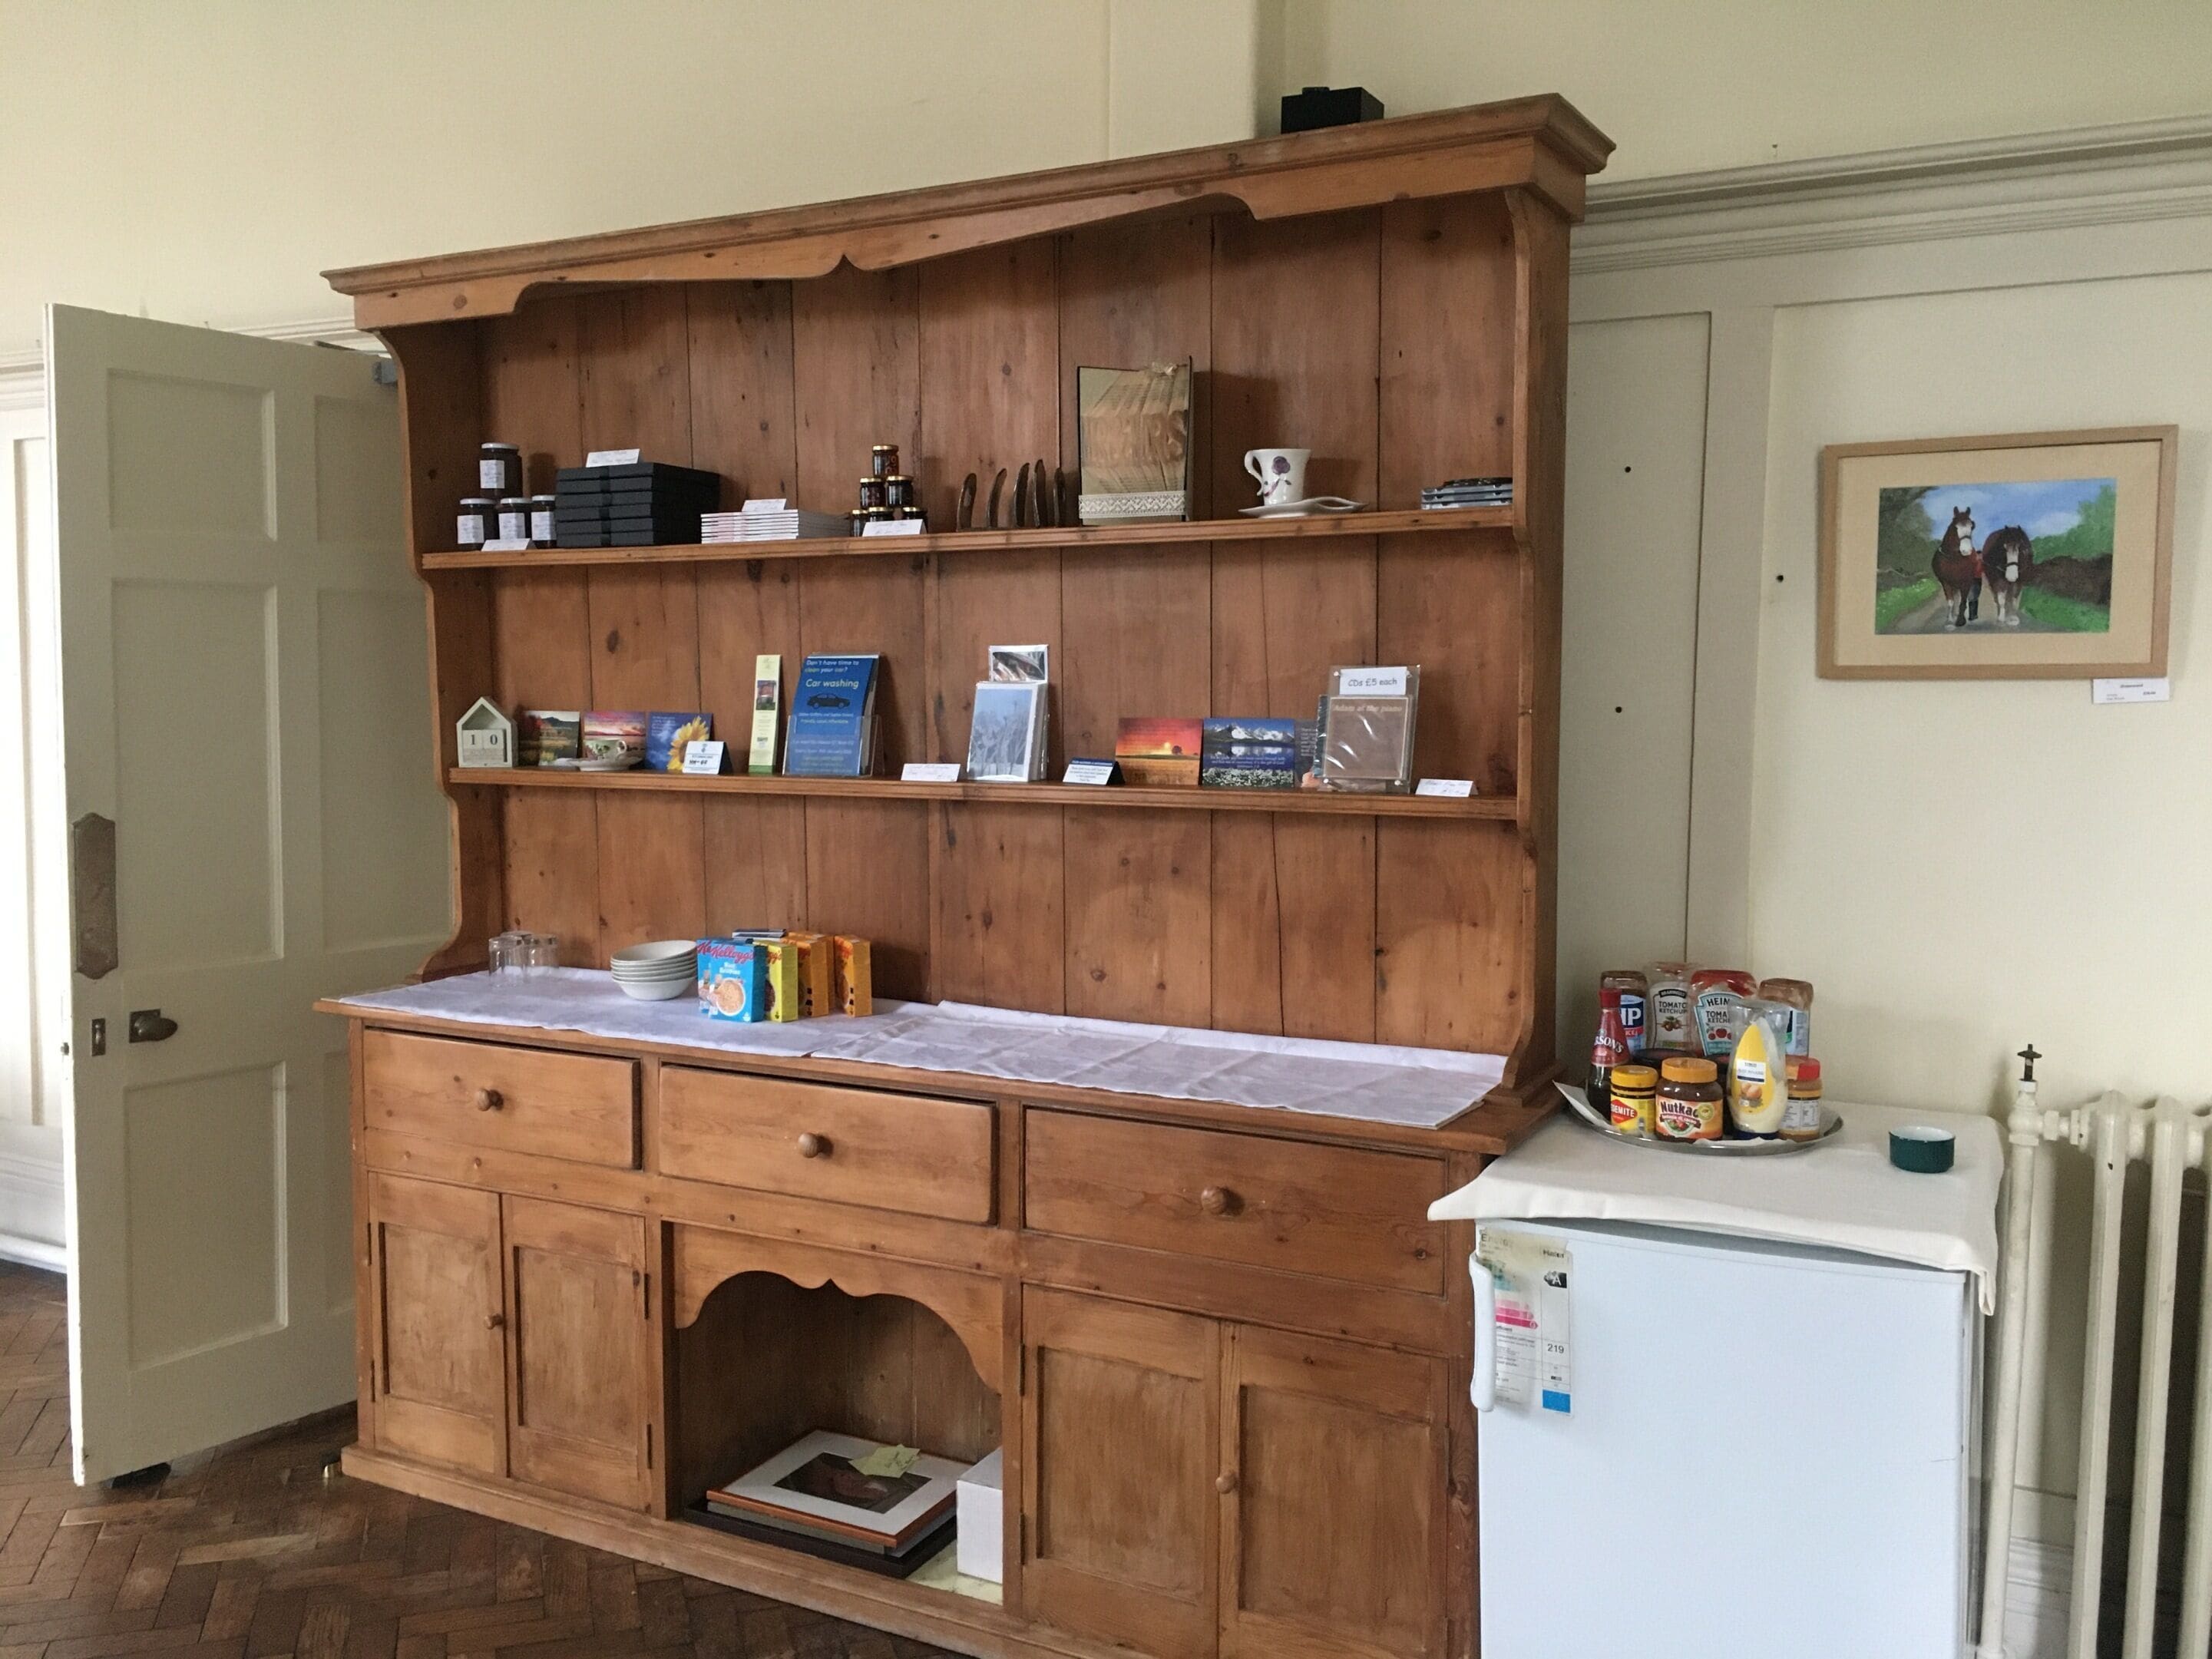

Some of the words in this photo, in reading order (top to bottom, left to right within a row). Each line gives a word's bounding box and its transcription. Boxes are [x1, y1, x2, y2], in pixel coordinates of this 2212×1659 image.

[805, 679, 821, 687] Car
[822, 678, 860, 689] washing
[1347, 679, 1364, 687] CDs
[1365, 678, 1377, 686] £5
[1379, 677, 1398, 686] each
[471, 734, 476, 745] 1
[490, 734, 498, 745] 0
[713, 943, 755, 964] Kellogg's
[1551, 1276, 1562, 1287] A
[1547, 1343, 1565, 1354] 219
